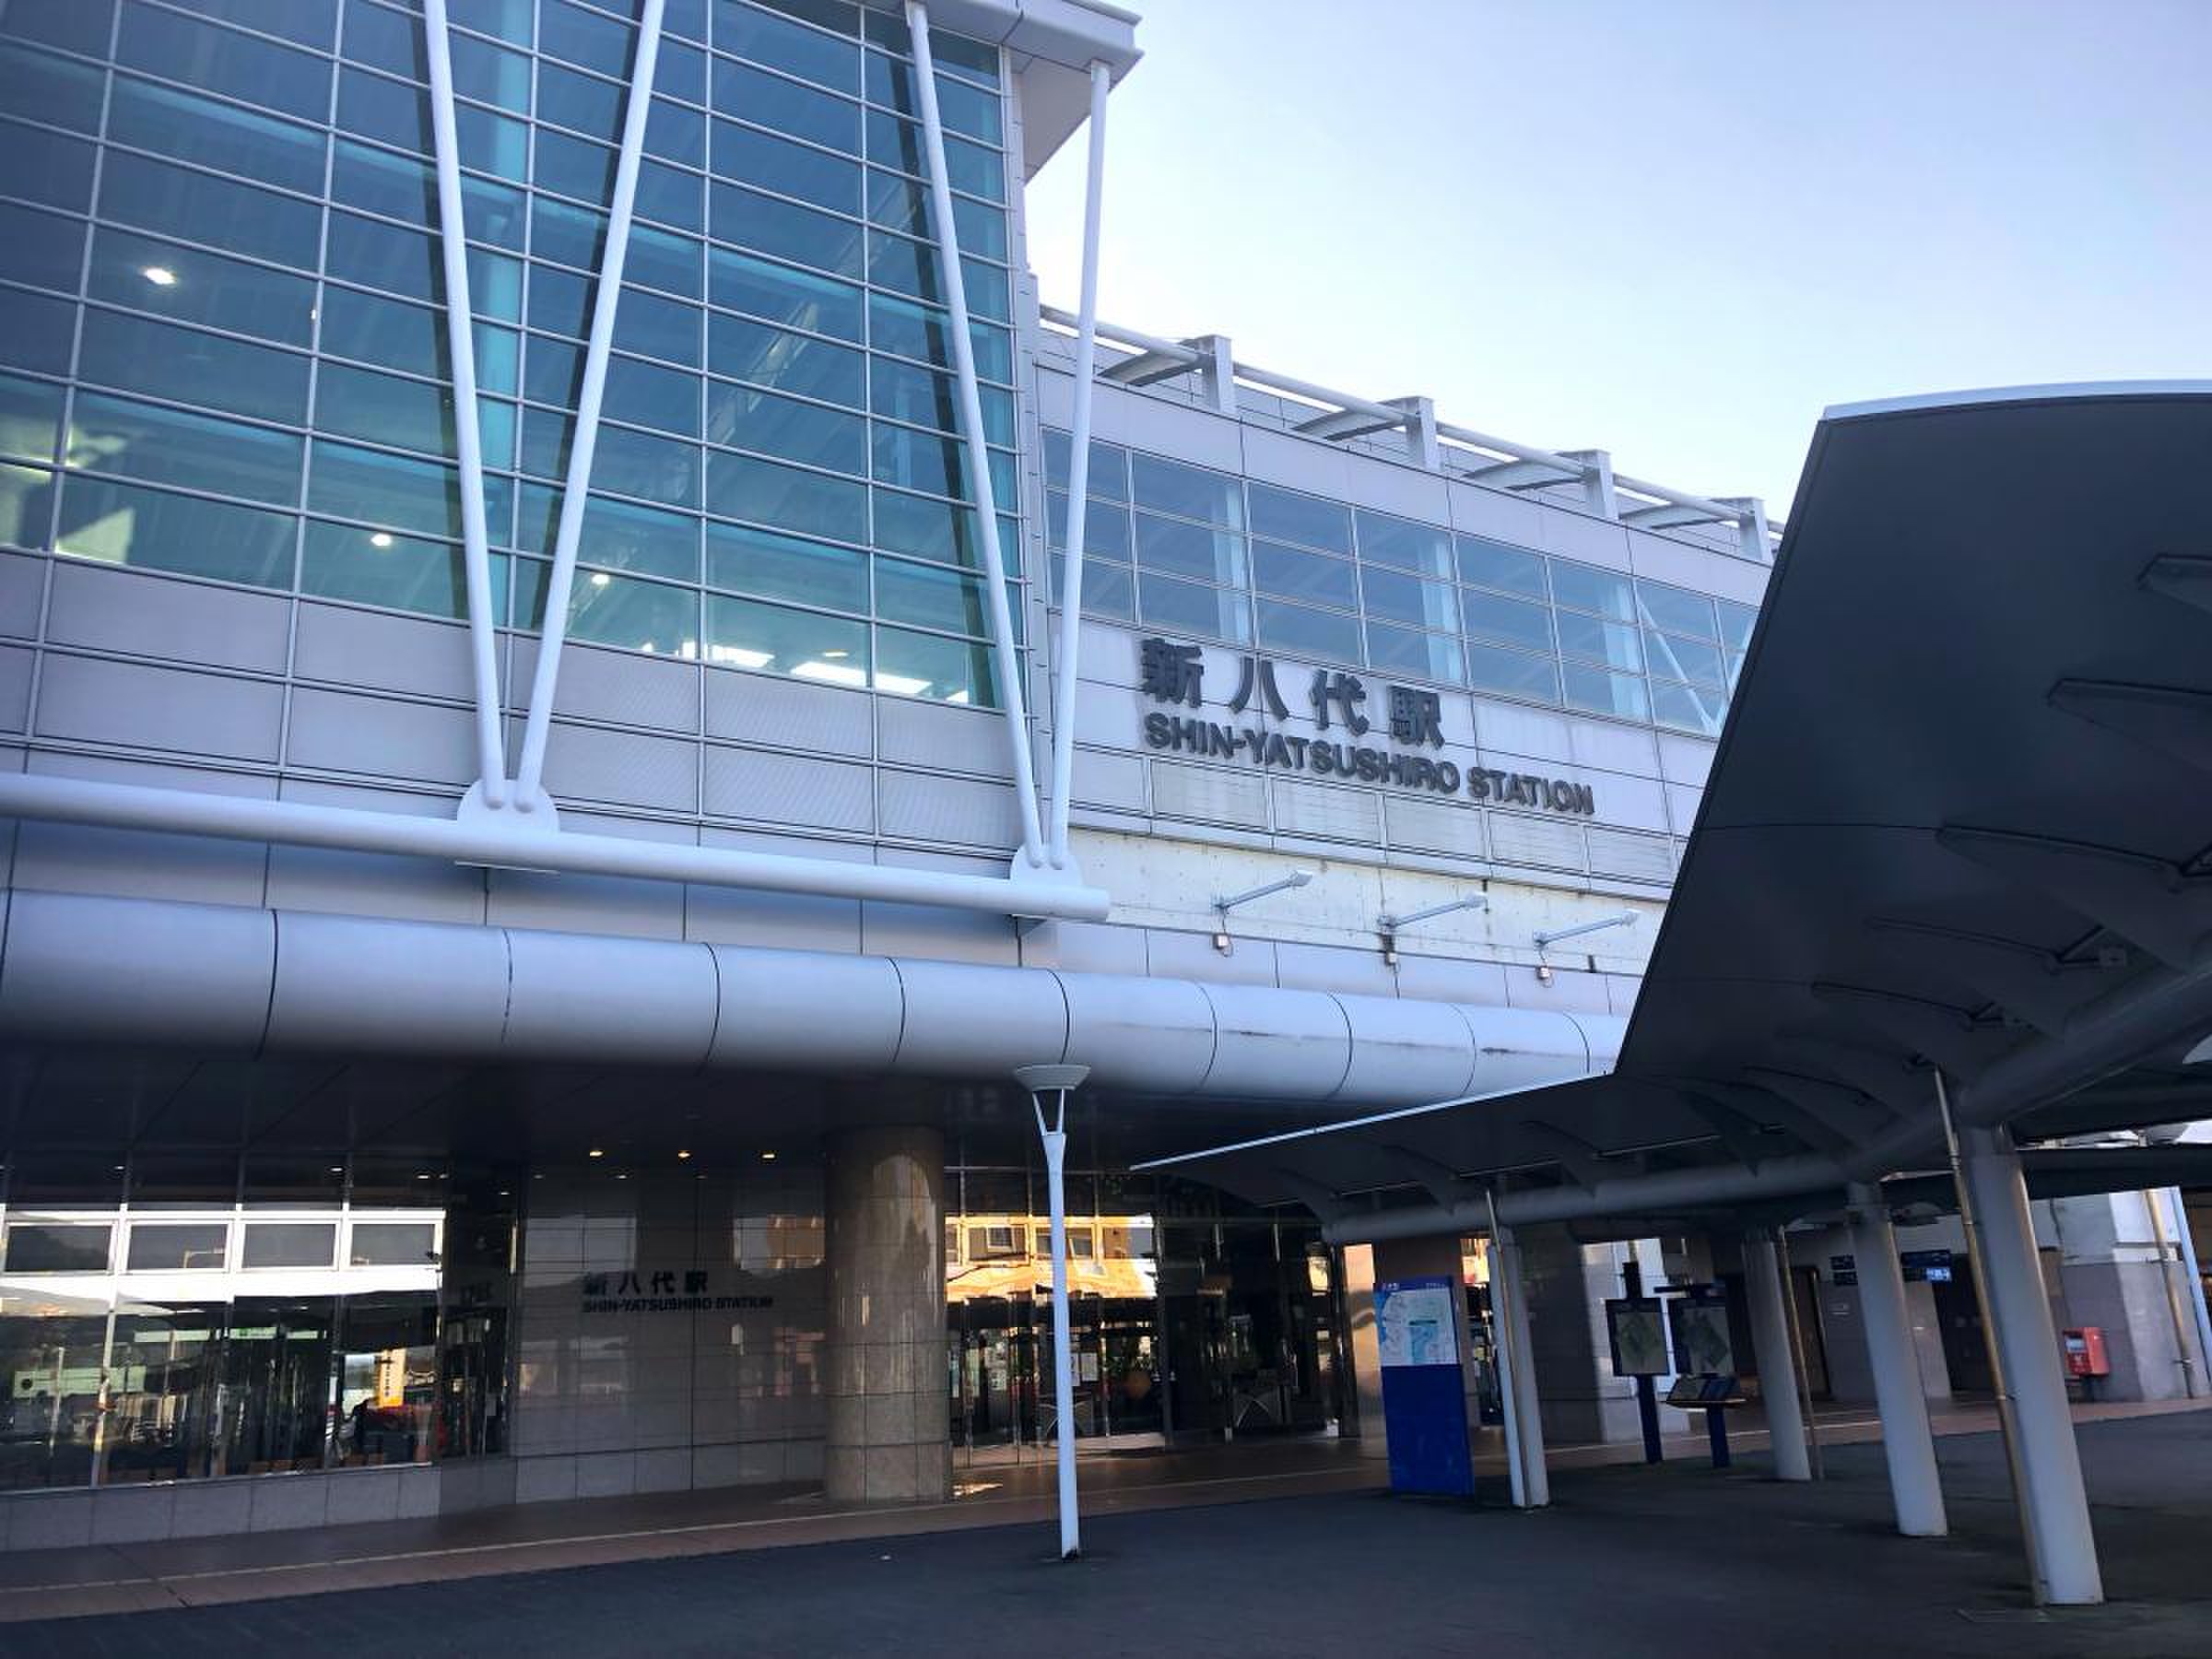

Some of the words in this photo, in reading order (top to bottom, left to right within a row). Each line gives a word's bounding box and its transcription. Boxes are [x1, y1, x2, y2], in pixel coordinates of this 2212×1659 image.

[1141, 637, 1444, 749] 新八代駅
[1143, 712, 1461, 794] SHIN-YATSUSHIRO
[1466, 766, 1595, 815] STATION
